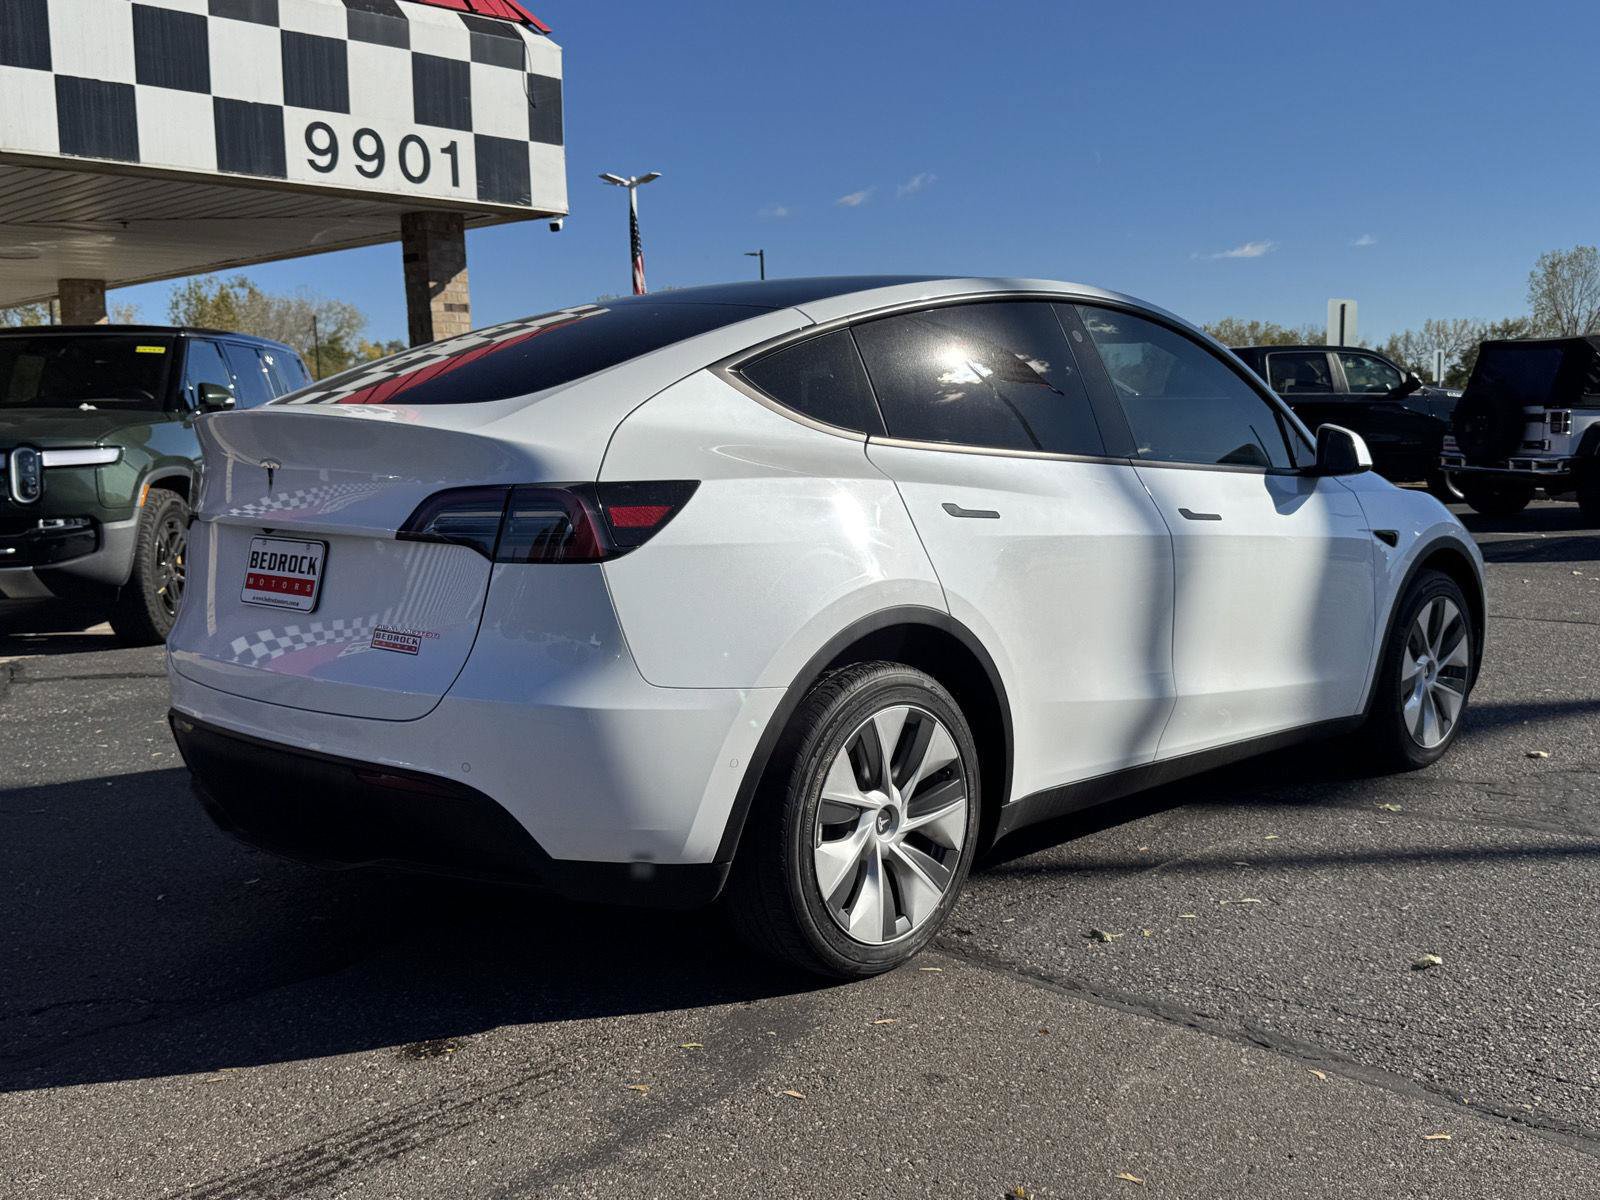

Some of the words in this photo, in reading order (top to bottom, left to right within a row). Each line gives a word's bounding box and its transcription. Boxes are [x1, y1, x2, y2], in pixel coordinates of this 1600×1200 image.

[304, 121, 460, 188] 9901
[249, 551, 319, 576] BEDROCK
[248, 577, 312, 592] MOTORS
[375, 631, 418, 646] BEDROCK
